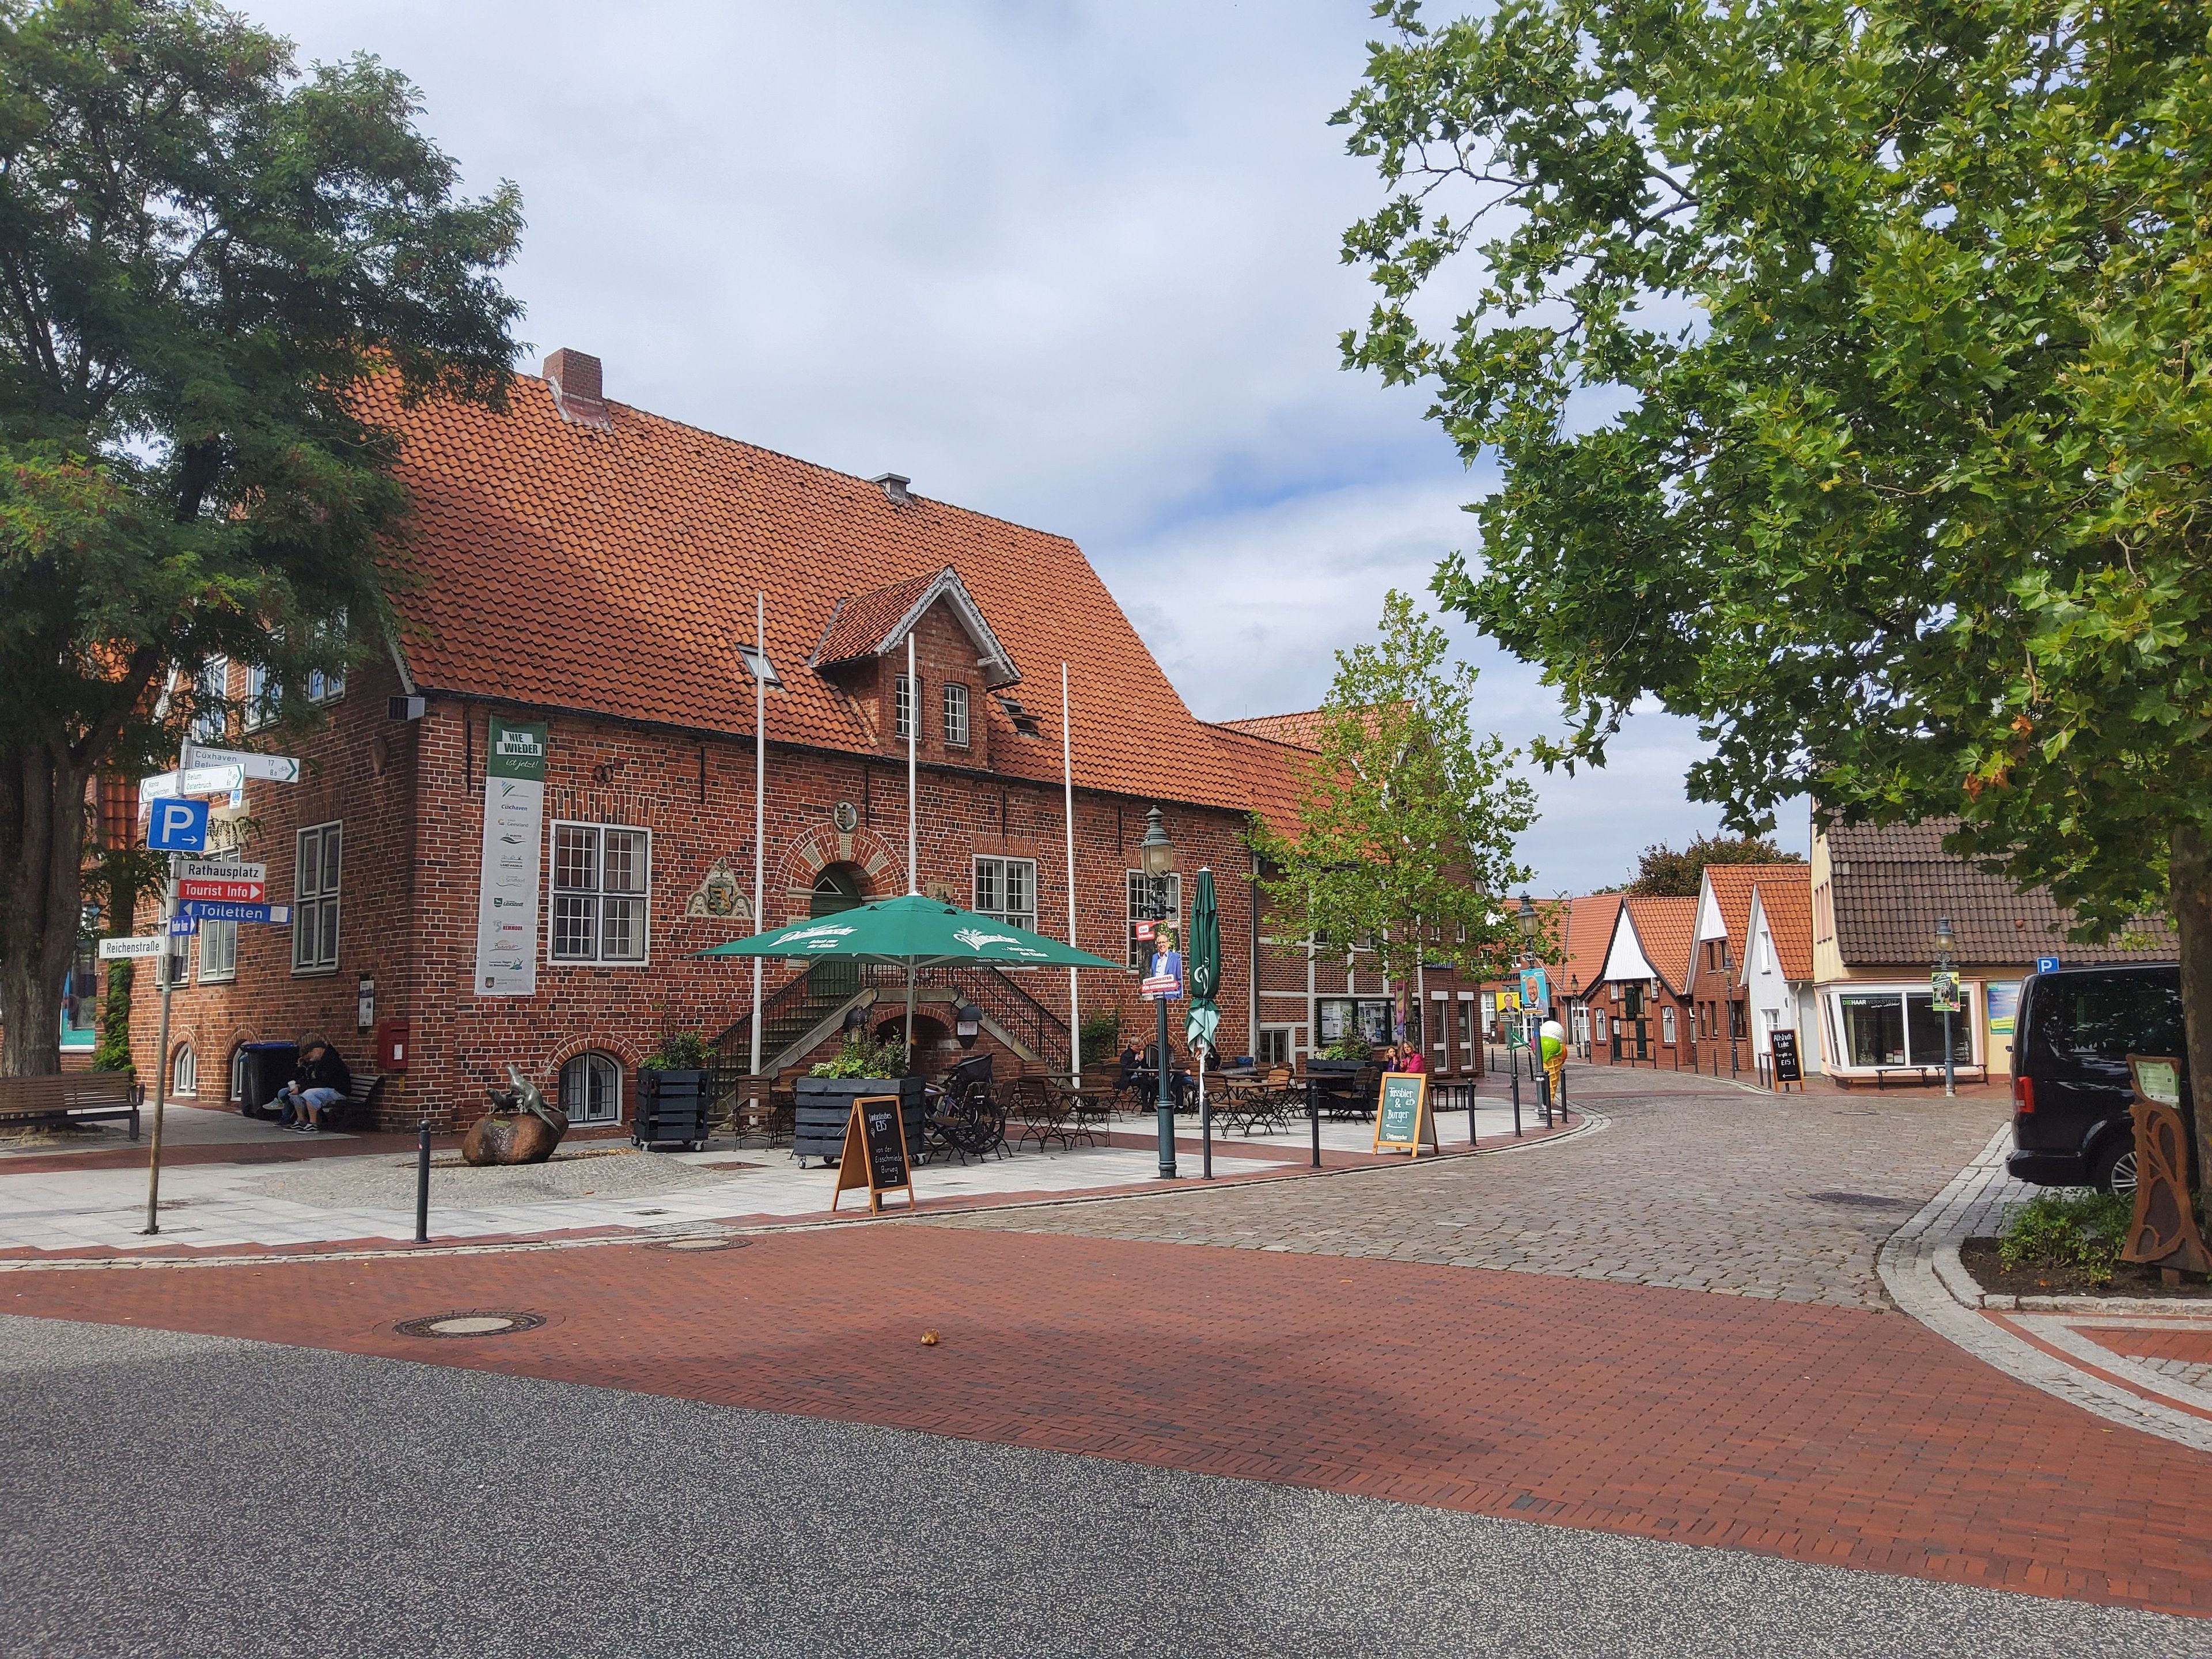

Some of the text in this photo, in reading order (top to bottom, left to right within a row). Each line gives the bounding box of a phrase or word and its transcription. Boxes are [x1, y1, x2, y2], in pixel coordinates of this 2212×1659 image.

[509, 733, 524, 743] NIE
[504, 743, 538, 754] WIEDER
[195, 751, 237, 763] Cuxhaven
[514, 760, 539, 770] jetzt!
[186, 782, 211, 790] Osterbruch
[162, 805, 194, 843] P
[188, 864, 259, 879] Rathausplatz
[185, 884, 248, 897] Tourist Info
[200, 904, 263, 919] Toiletten
[107, 941, 160, 954] Reichenstraße
[2041, 960, 2052, 972] P
[1774, 1033, 1794, 1041] Altstadt-
[1388, 1087, 1414, 1098] Fassbier
[1395, 1098, 1402, 1108] &
[868, 1112, 892, 1123] fantastisches
[1387, 1109, 1410, 1123] Burger
[876, 1120, 887, 1132] EIS
[874, 1152, 903, 1163] Eisschmiede
[881, 1165, 898, 1175] Burweg
